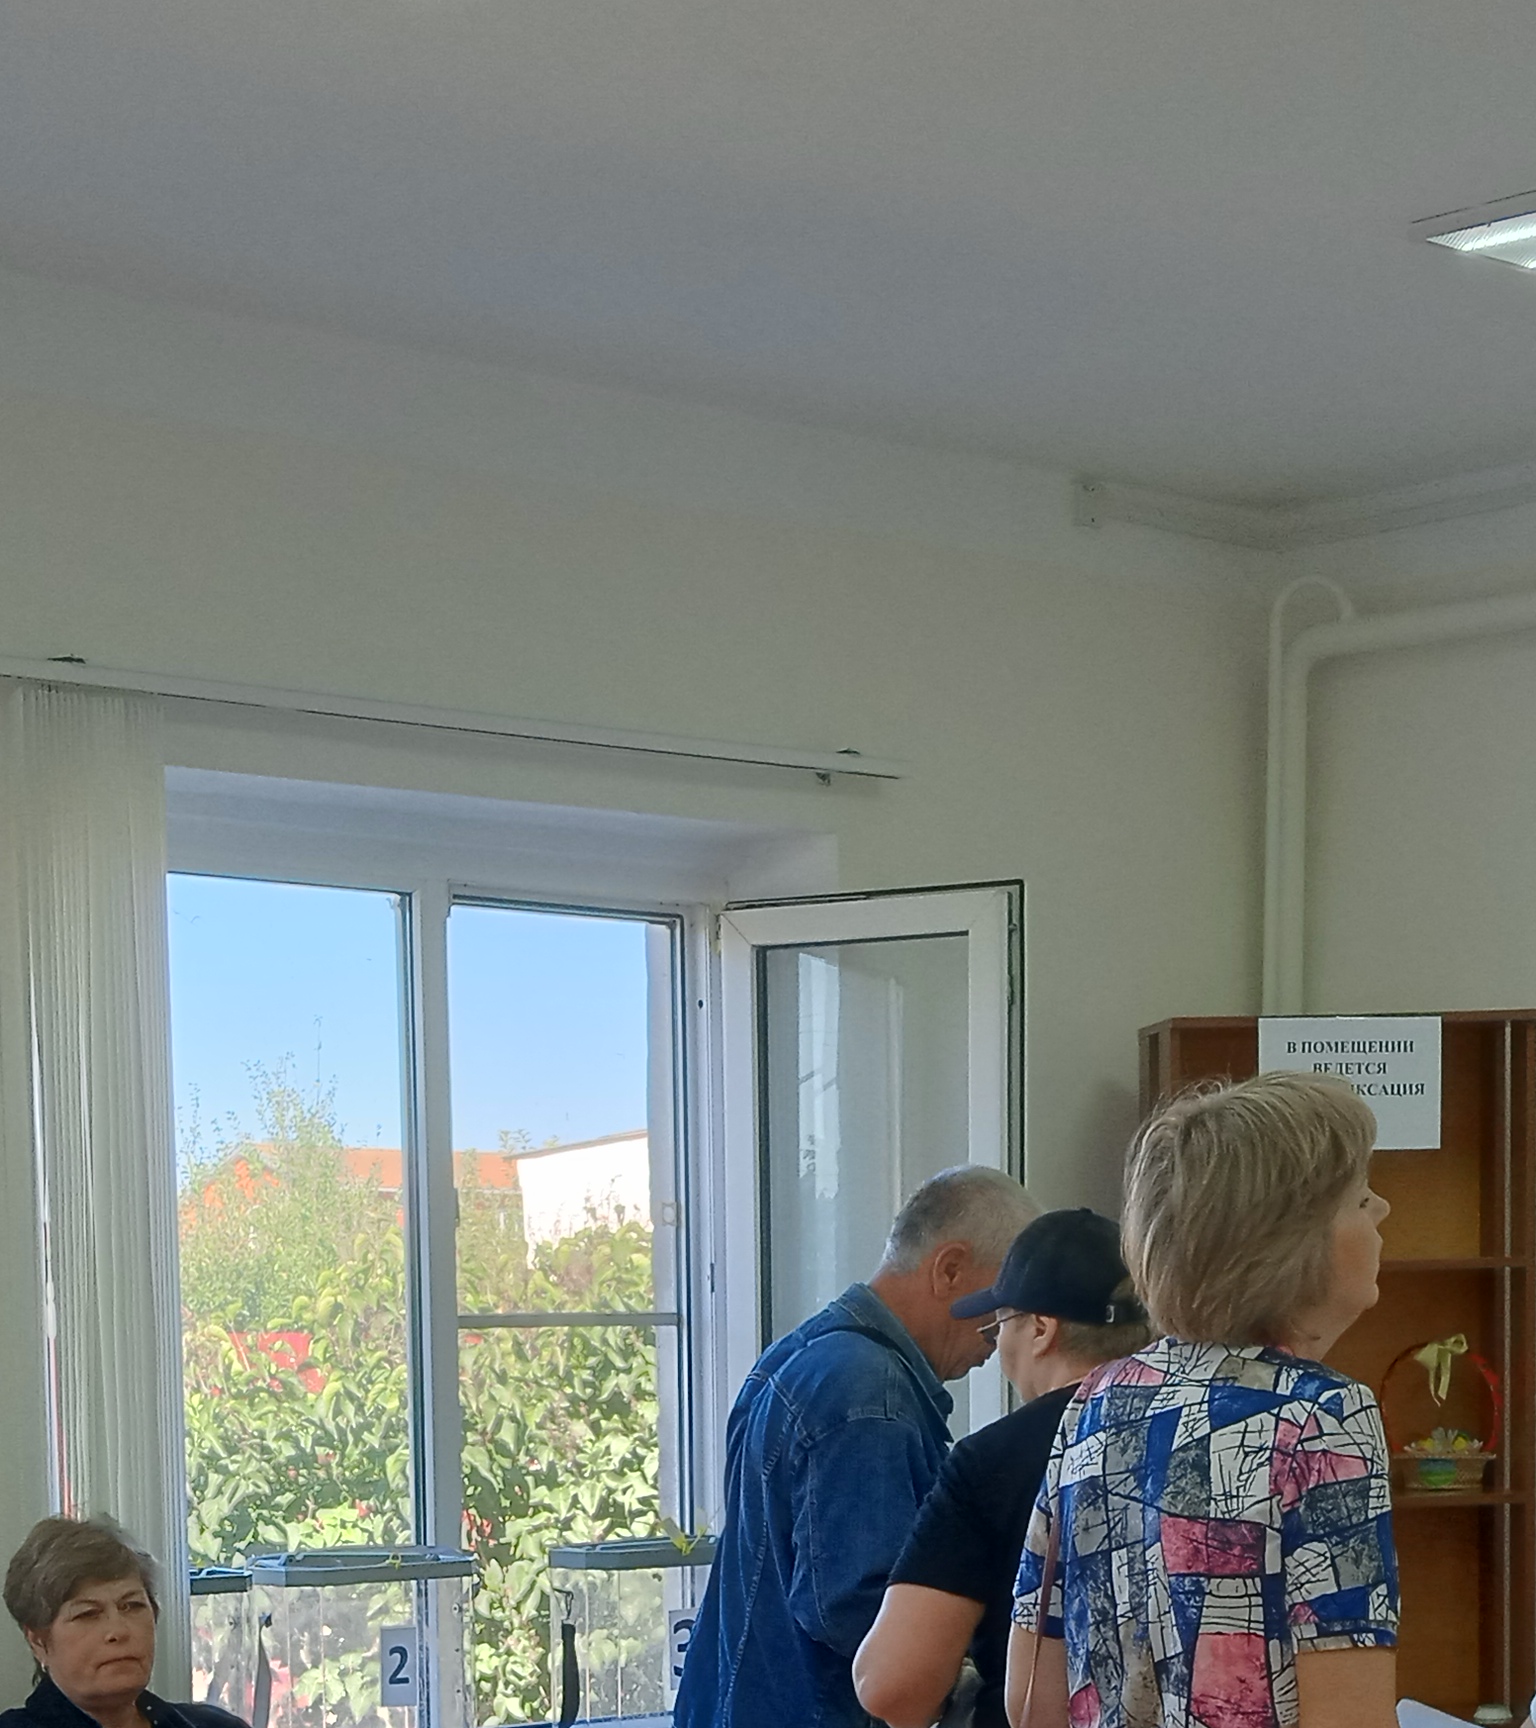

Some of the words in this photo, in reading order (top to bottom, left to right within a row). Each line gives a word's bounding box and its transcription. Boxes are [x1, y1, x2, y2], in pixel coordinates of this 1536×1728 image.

[1287, 1041, 1297, 1053] В
[1301, 1040, 1414, 1055] ПОМЕЩЕНИИ
[1313, 1062, 1387, 1076] ВЕДЕТСЯ
[389, 1646, 410, 1685] 2
